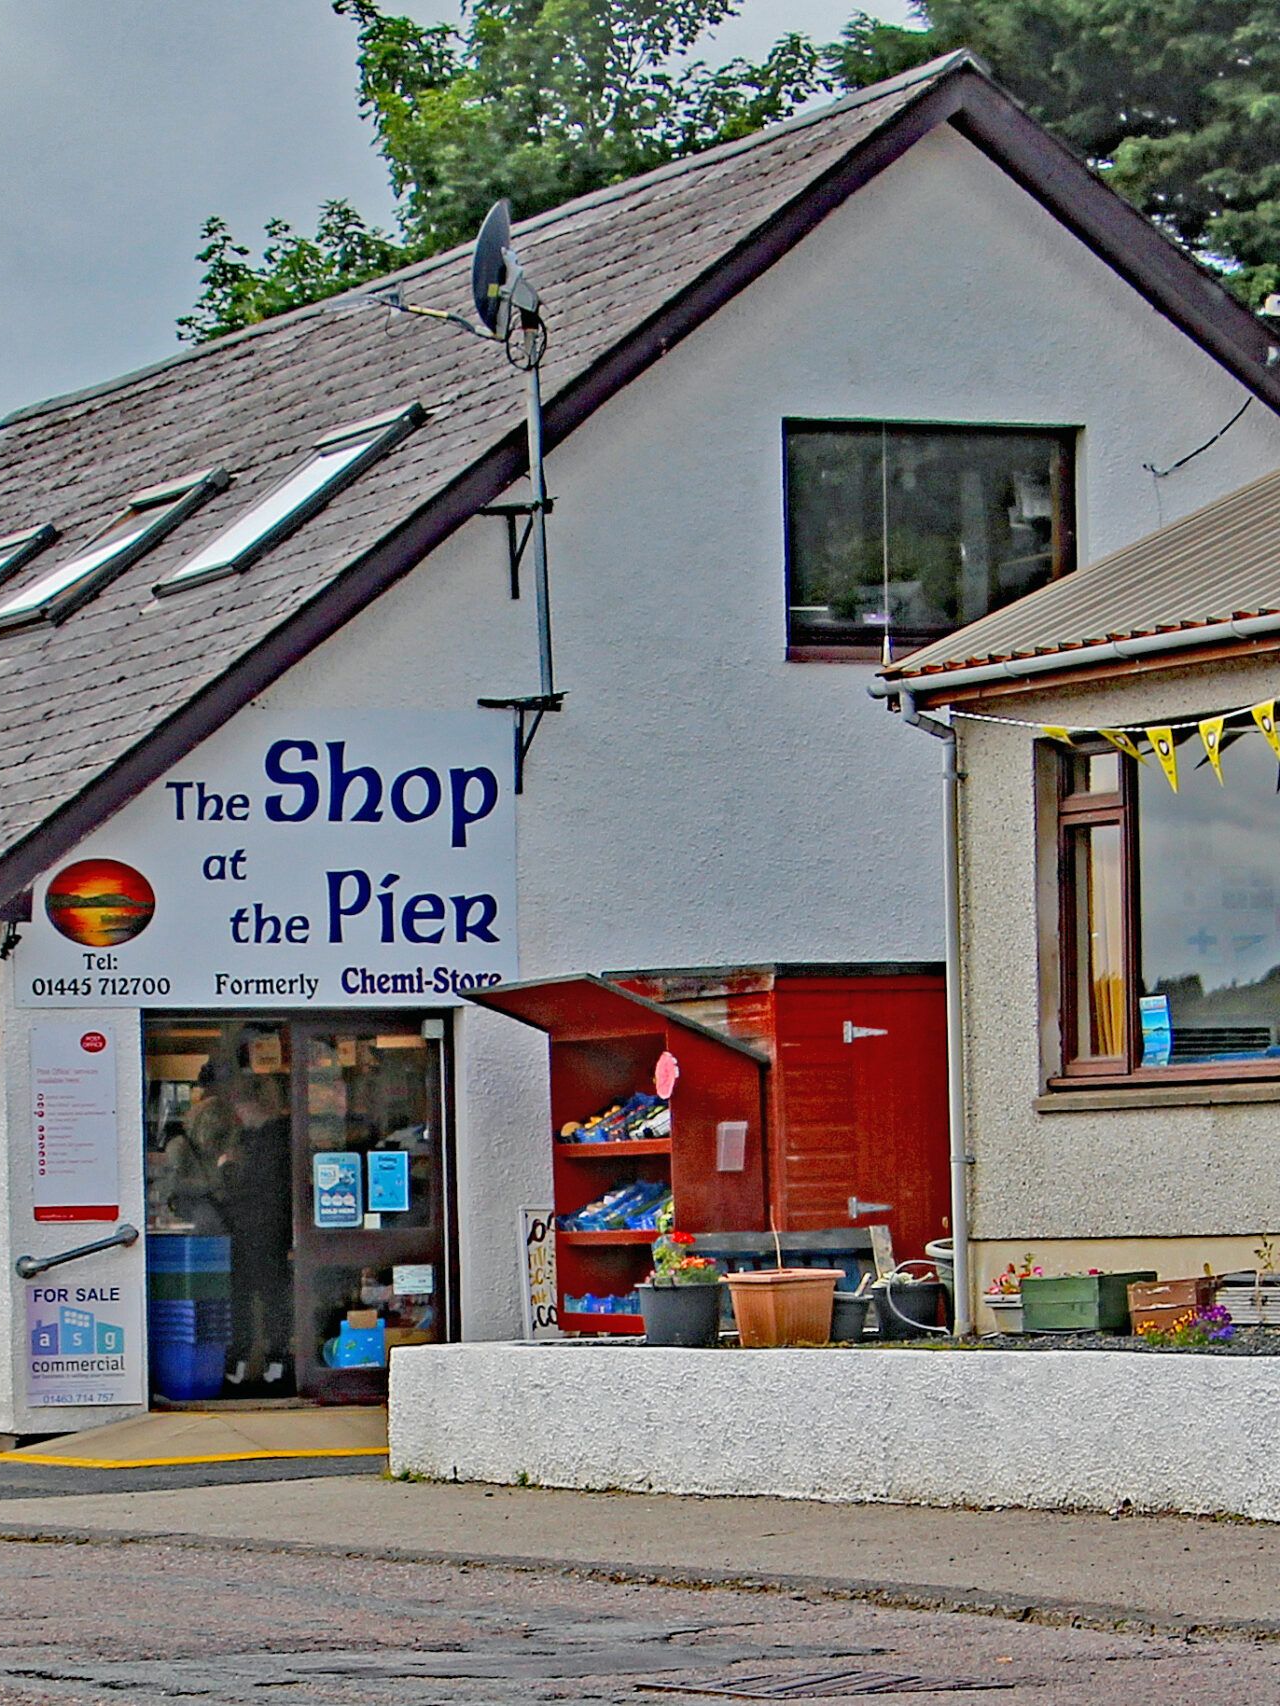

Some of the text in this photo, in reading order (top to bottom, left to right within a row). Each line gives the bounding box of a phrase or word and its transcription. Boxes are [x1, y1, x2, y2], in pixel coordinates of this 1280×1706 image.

[165, 739, 499, 848] The Shop
[202, 849, 248, 881] at
[229, 902, 311, 944] the
[82, 952, 118, 970] Tel:
[31, 977, 171, 996] 01445 712700
[214, 966, 503, 999] Formerly Chemi-Store
[33, 1287, 121, 1303] FOR SALE
[31, 1355, 125, 1373] commercial
